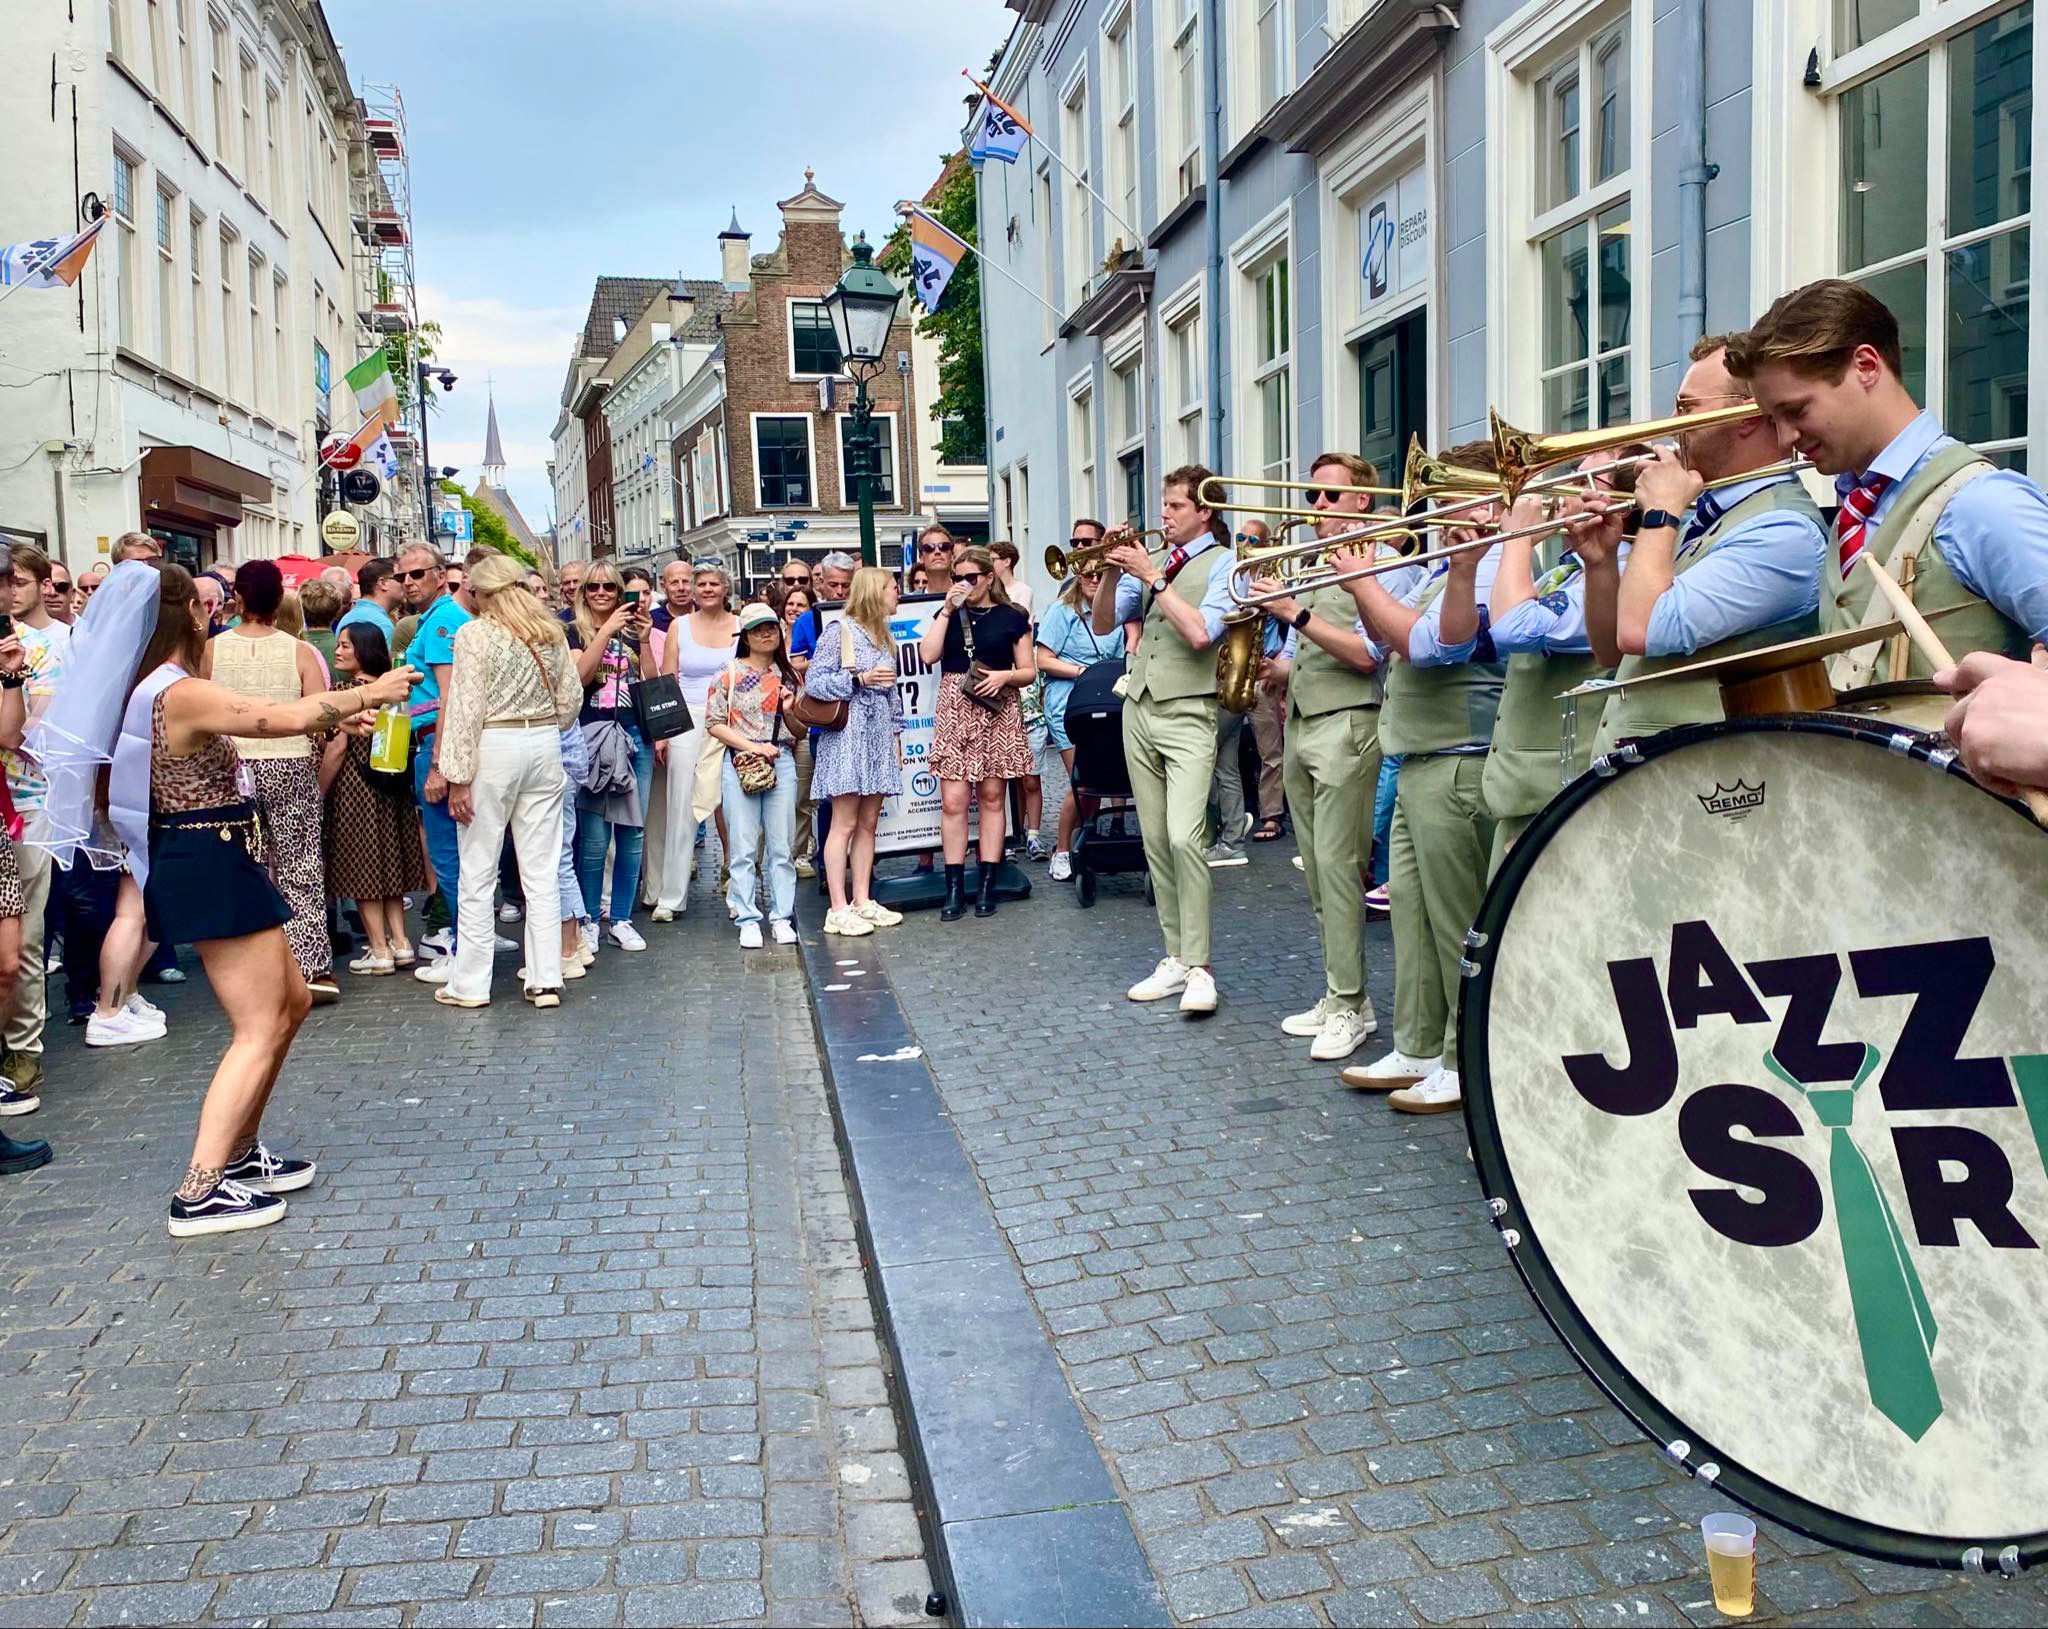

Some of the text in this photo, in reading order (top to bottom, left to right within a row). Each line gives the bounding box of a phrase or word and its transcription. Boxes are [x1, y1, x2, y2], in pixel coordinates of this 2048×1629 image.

[650, 704, 661, 713] THE
[906, 744, 924, 755] 30
[1710, 792, 1759, 810] REMO
[1562, 920, 2018, 1116] JAZZ
